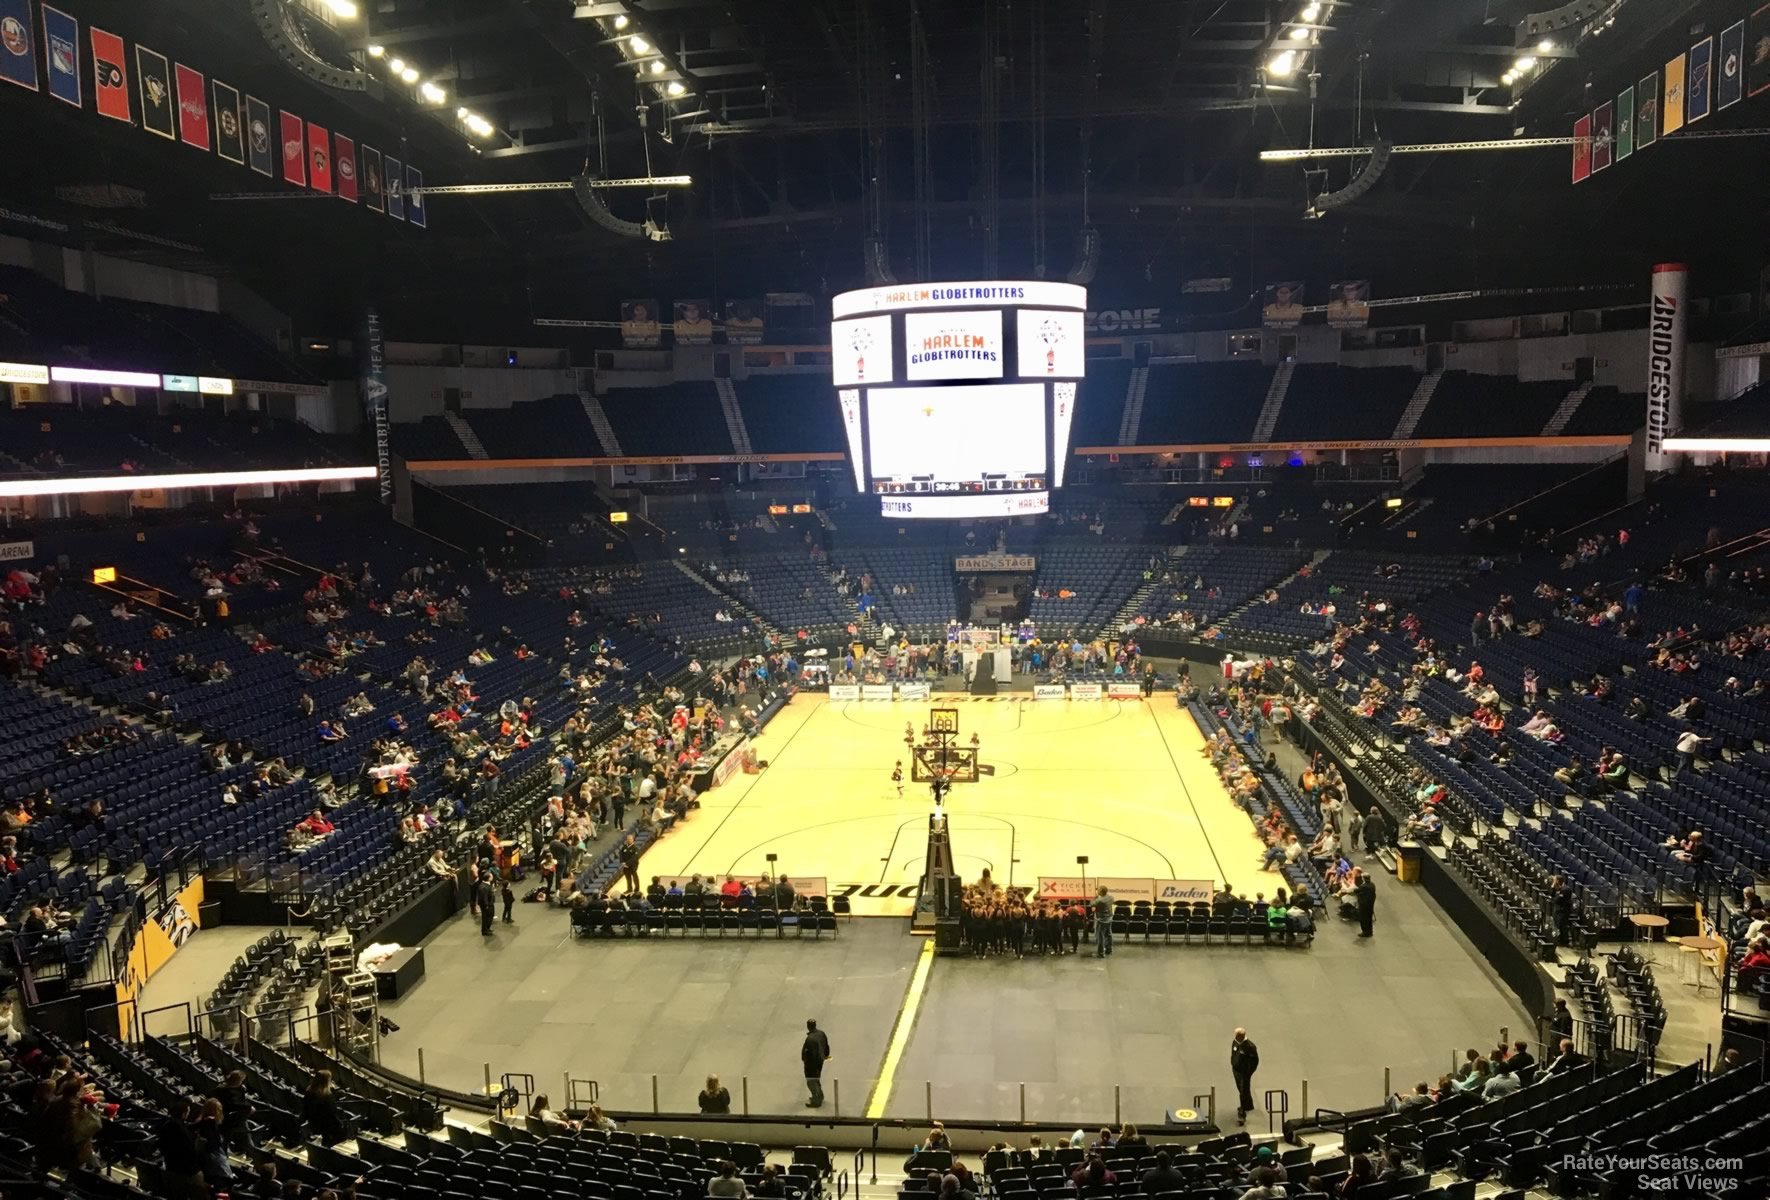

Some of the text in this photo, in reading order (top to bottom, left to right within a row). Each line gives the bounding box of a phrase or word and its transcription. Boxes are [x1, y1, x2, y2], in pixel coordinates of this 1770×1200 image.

[886, 287, 1025, 303] HARLEM GLOBETROTTERS
[367, 313, 383, 374] HEALTH
[923, 335, 984, 350] HARLEM
[912, 349, 997, 364] GLOBETROTTERS
[1648, 294, 1677, 455] BRIDGESTONE
[375, 405, 392, 497] VANDERBILT
[0, 545, 30, 558] ARENA
[998, 558, 1034, 567] STAGE
[1161, 885, 1209, 898] Baden
